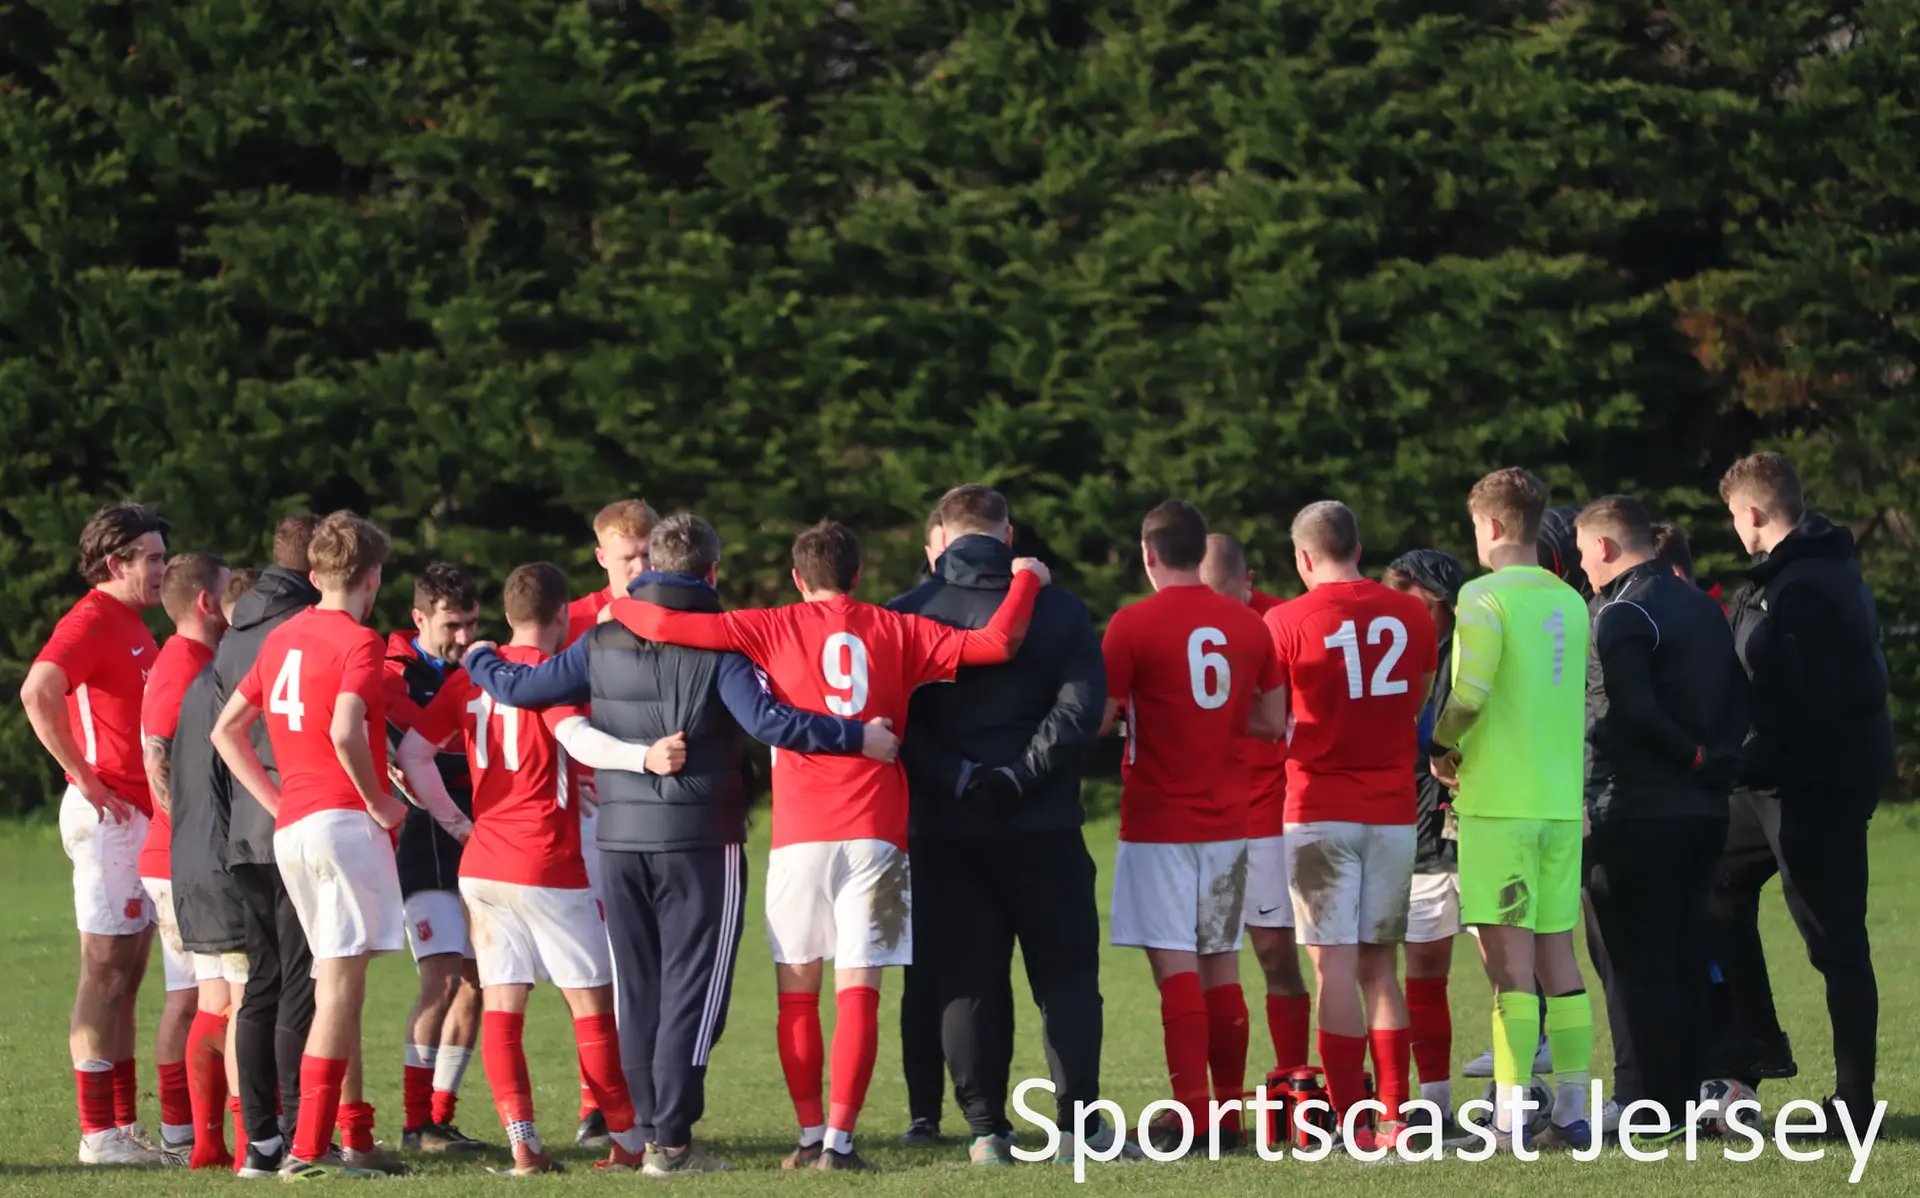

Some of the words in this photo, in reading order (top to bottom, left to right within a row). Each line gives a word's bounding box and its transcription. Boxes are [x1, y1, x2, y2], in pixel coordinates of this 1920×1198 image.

[822, 631, 869, 716] 9
[1187, 626, 1232, 709] 6
[1323, 615, 1409, 699] 12
[1542, 606, 1564, 686] 1
[269, 648, 305, 732] 4
[466, 689, 520, 771] 11
